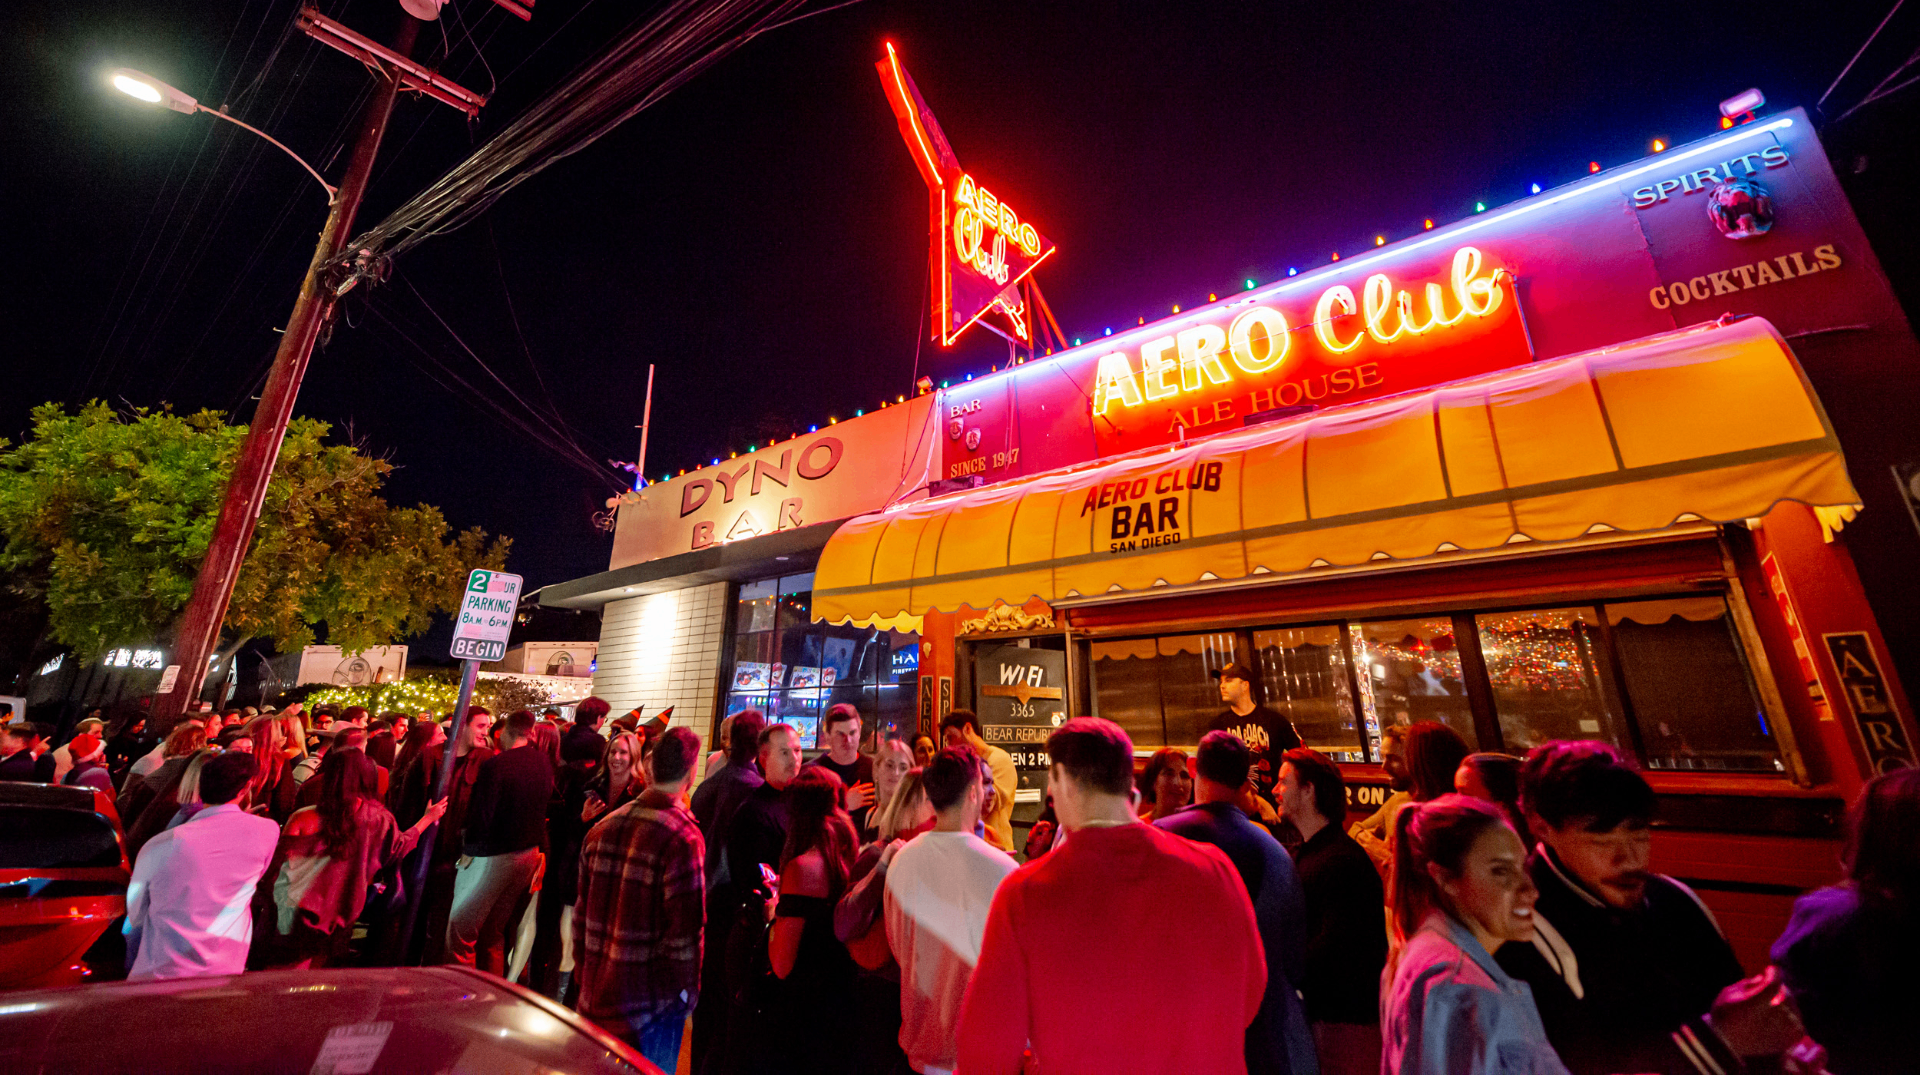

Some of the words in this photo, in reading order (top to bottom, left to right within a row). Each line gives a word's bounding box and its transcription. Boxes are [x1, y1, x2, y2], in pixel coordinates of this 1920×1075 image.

[1632, 144, 1790, 208] SPIRITS
[954, 174, 1041, 256] AERO
[954, 207, 1009, 286] Club
[1649, 243, 1843, 310] COCKTAILS
[1092, 305, 1292, 417] AERO
[1311, 245, 1505, 354] Club
[950, 398, 982, 418] BAR
[1166, 397, 1236, 434] ALE
[1249, 361, 1385, 413] HOUSE
[680, 436, 844, 518] DYNO
[950, 456, 987, 479] SINCE
[992, 447, 1020, 469] 1947
[1081, 478, 1149, 518] AERO
[1154, 461, 1223, 495] CLUB
[691, 497, 804, 550] BAR
[1111, 497, 1180, 540] BAR
[1110, 540, 1137, 554] SAN
[1141, 532, 1181, 550] DIEGO
[472, 573, 487, 590] 2
[467, 595, 512, 613] PARKING
[455, 639, 503, 658] BEGIN
[1010, 702, 1035, 718] 3365
[986, 727, 1013, 741] BEAR
[1028, 753, 1036, 766] 2
[1357, 786, 1384, 805] ON
